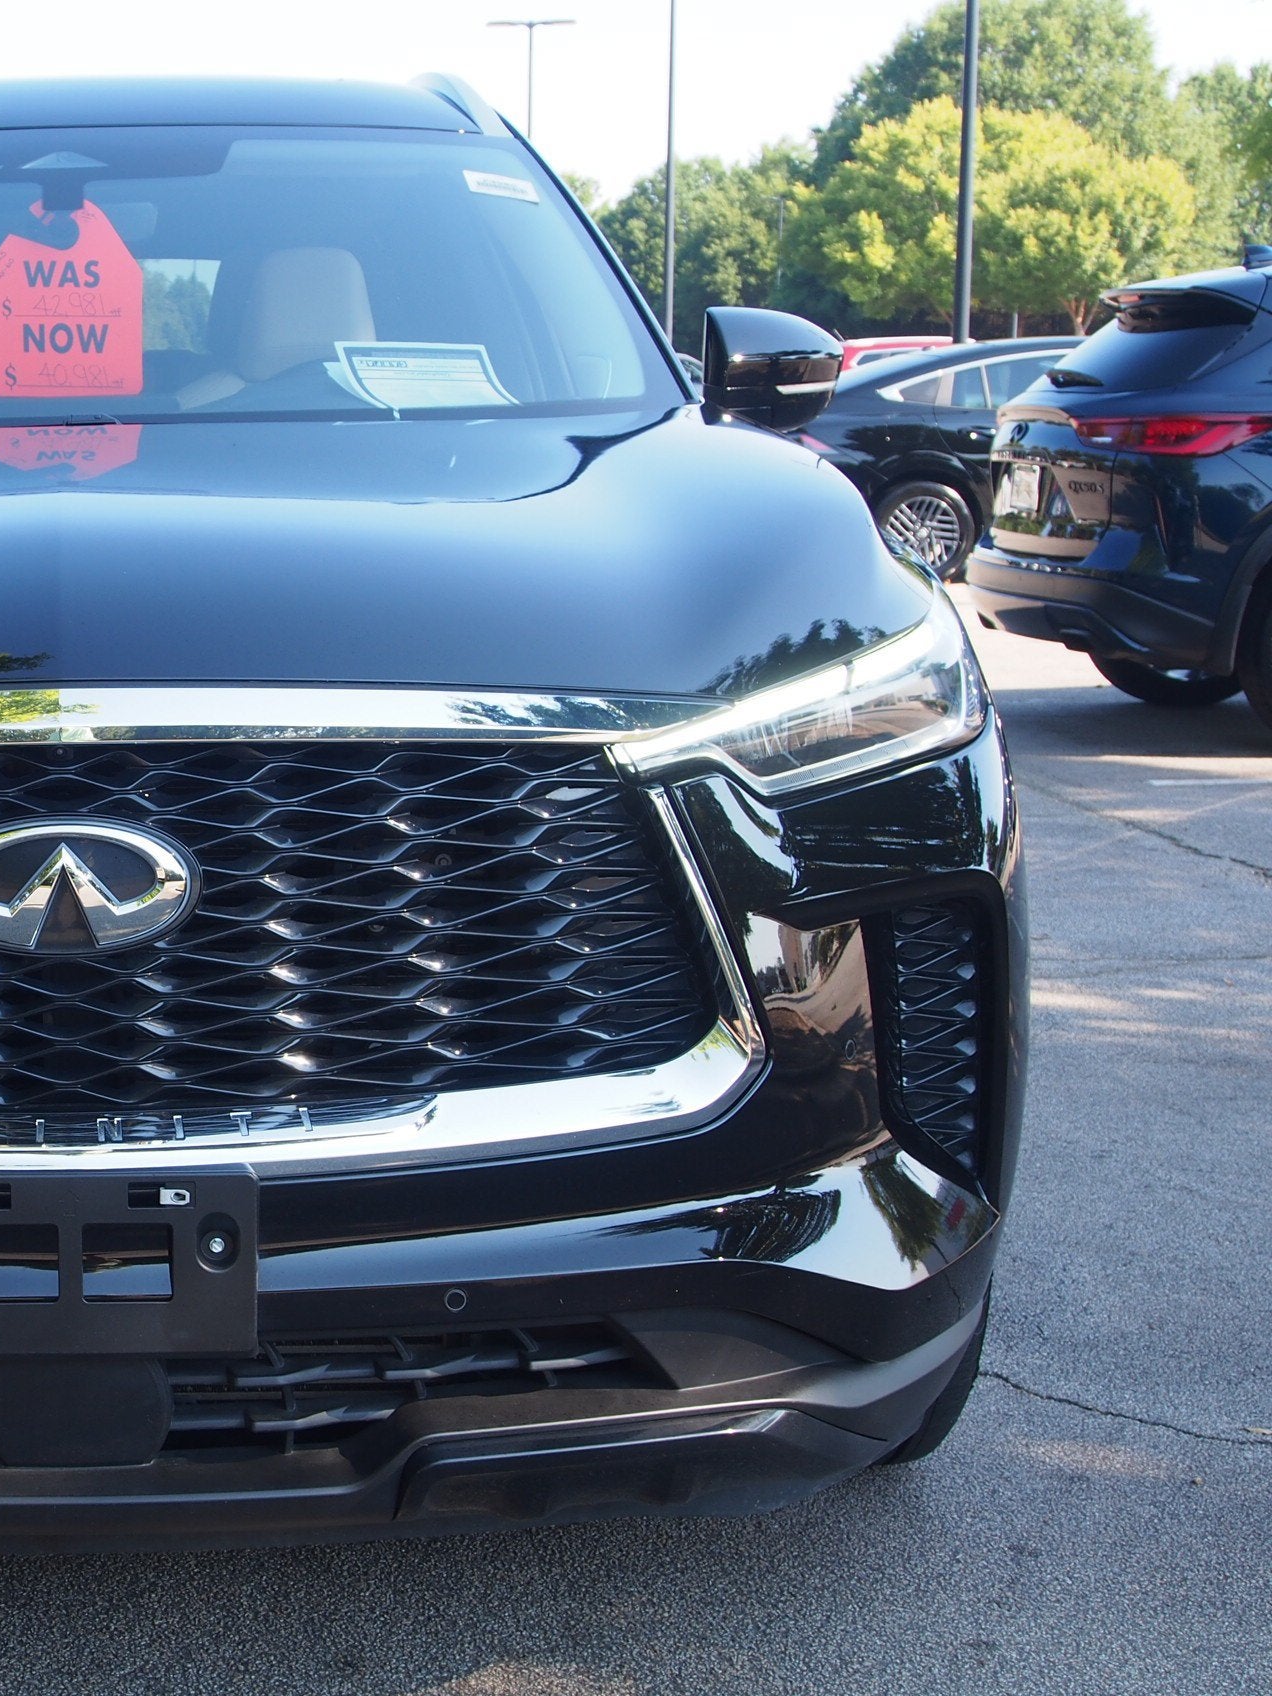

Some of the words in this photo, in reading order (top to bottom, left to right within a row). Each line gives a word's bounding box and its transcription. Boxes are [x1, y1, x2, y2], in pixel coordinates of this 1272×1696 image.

[24, 260, 101, 288] WAS
[2, 297, 12, 320] $
[23, 323, 108, 353] NOW
[5, 363, 17, 390] $
